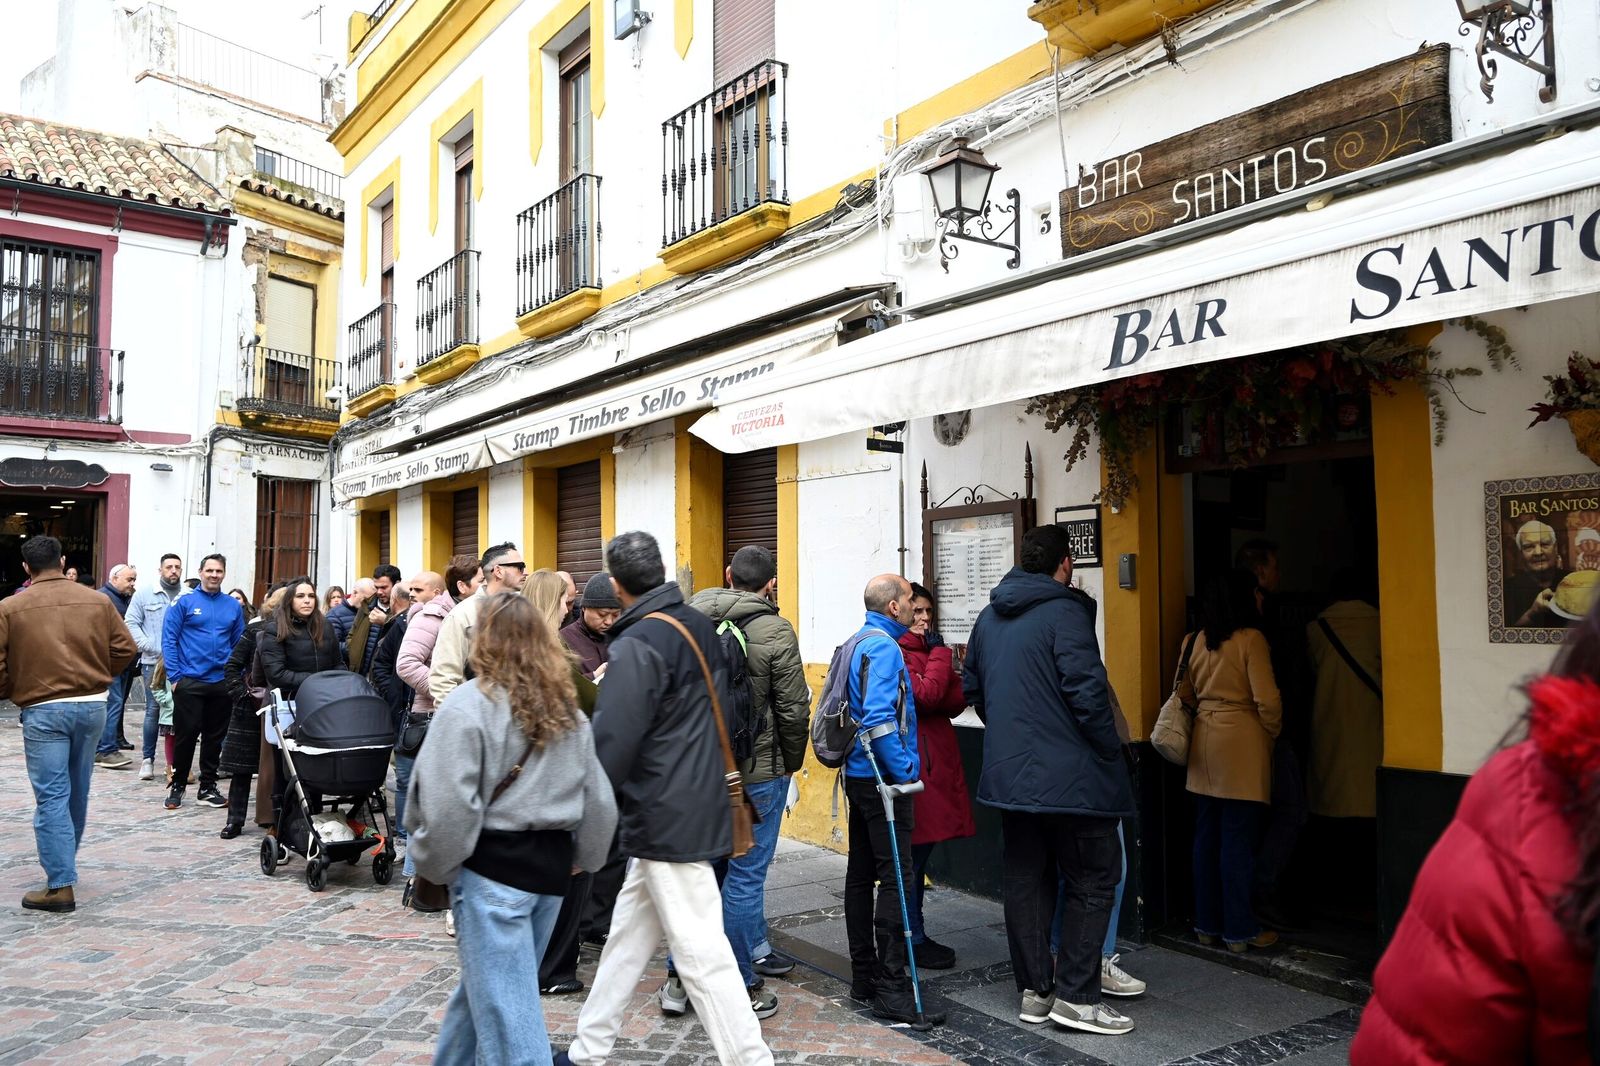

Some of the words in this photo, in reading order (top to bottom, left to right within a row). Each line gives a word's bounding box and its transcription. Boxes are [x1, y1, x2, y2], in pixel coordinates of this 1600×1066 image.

[1077, 152, 1144, 208] BAR
[1172, 136, 1327, 223] SANTOS
[1040, 212, 1051, 235] 3
[1102, 298, 1227, 371] BAR
[512, 426, 560, 448] Stamp
[568, 405, 630, 435] Timbre
[638, 386, 686, 417] Sello
[736, 402, 784, 421] CERVEZAS
[731, 413, 785, 436] VICTORIA
[342, 481, 366, 496] Stamp
[371, 470, 401, 489] Timbre
[406, 461, 429, 480] Sello
[434, 451, 470, 470] Stamp
[1510, 499, 1538, 518] BAR
[1540, 497, 1599, 516] SANTOS
[1067, 523, 1094, 537] GLUTEN
[1069, 536, 1095, 555] FREE
